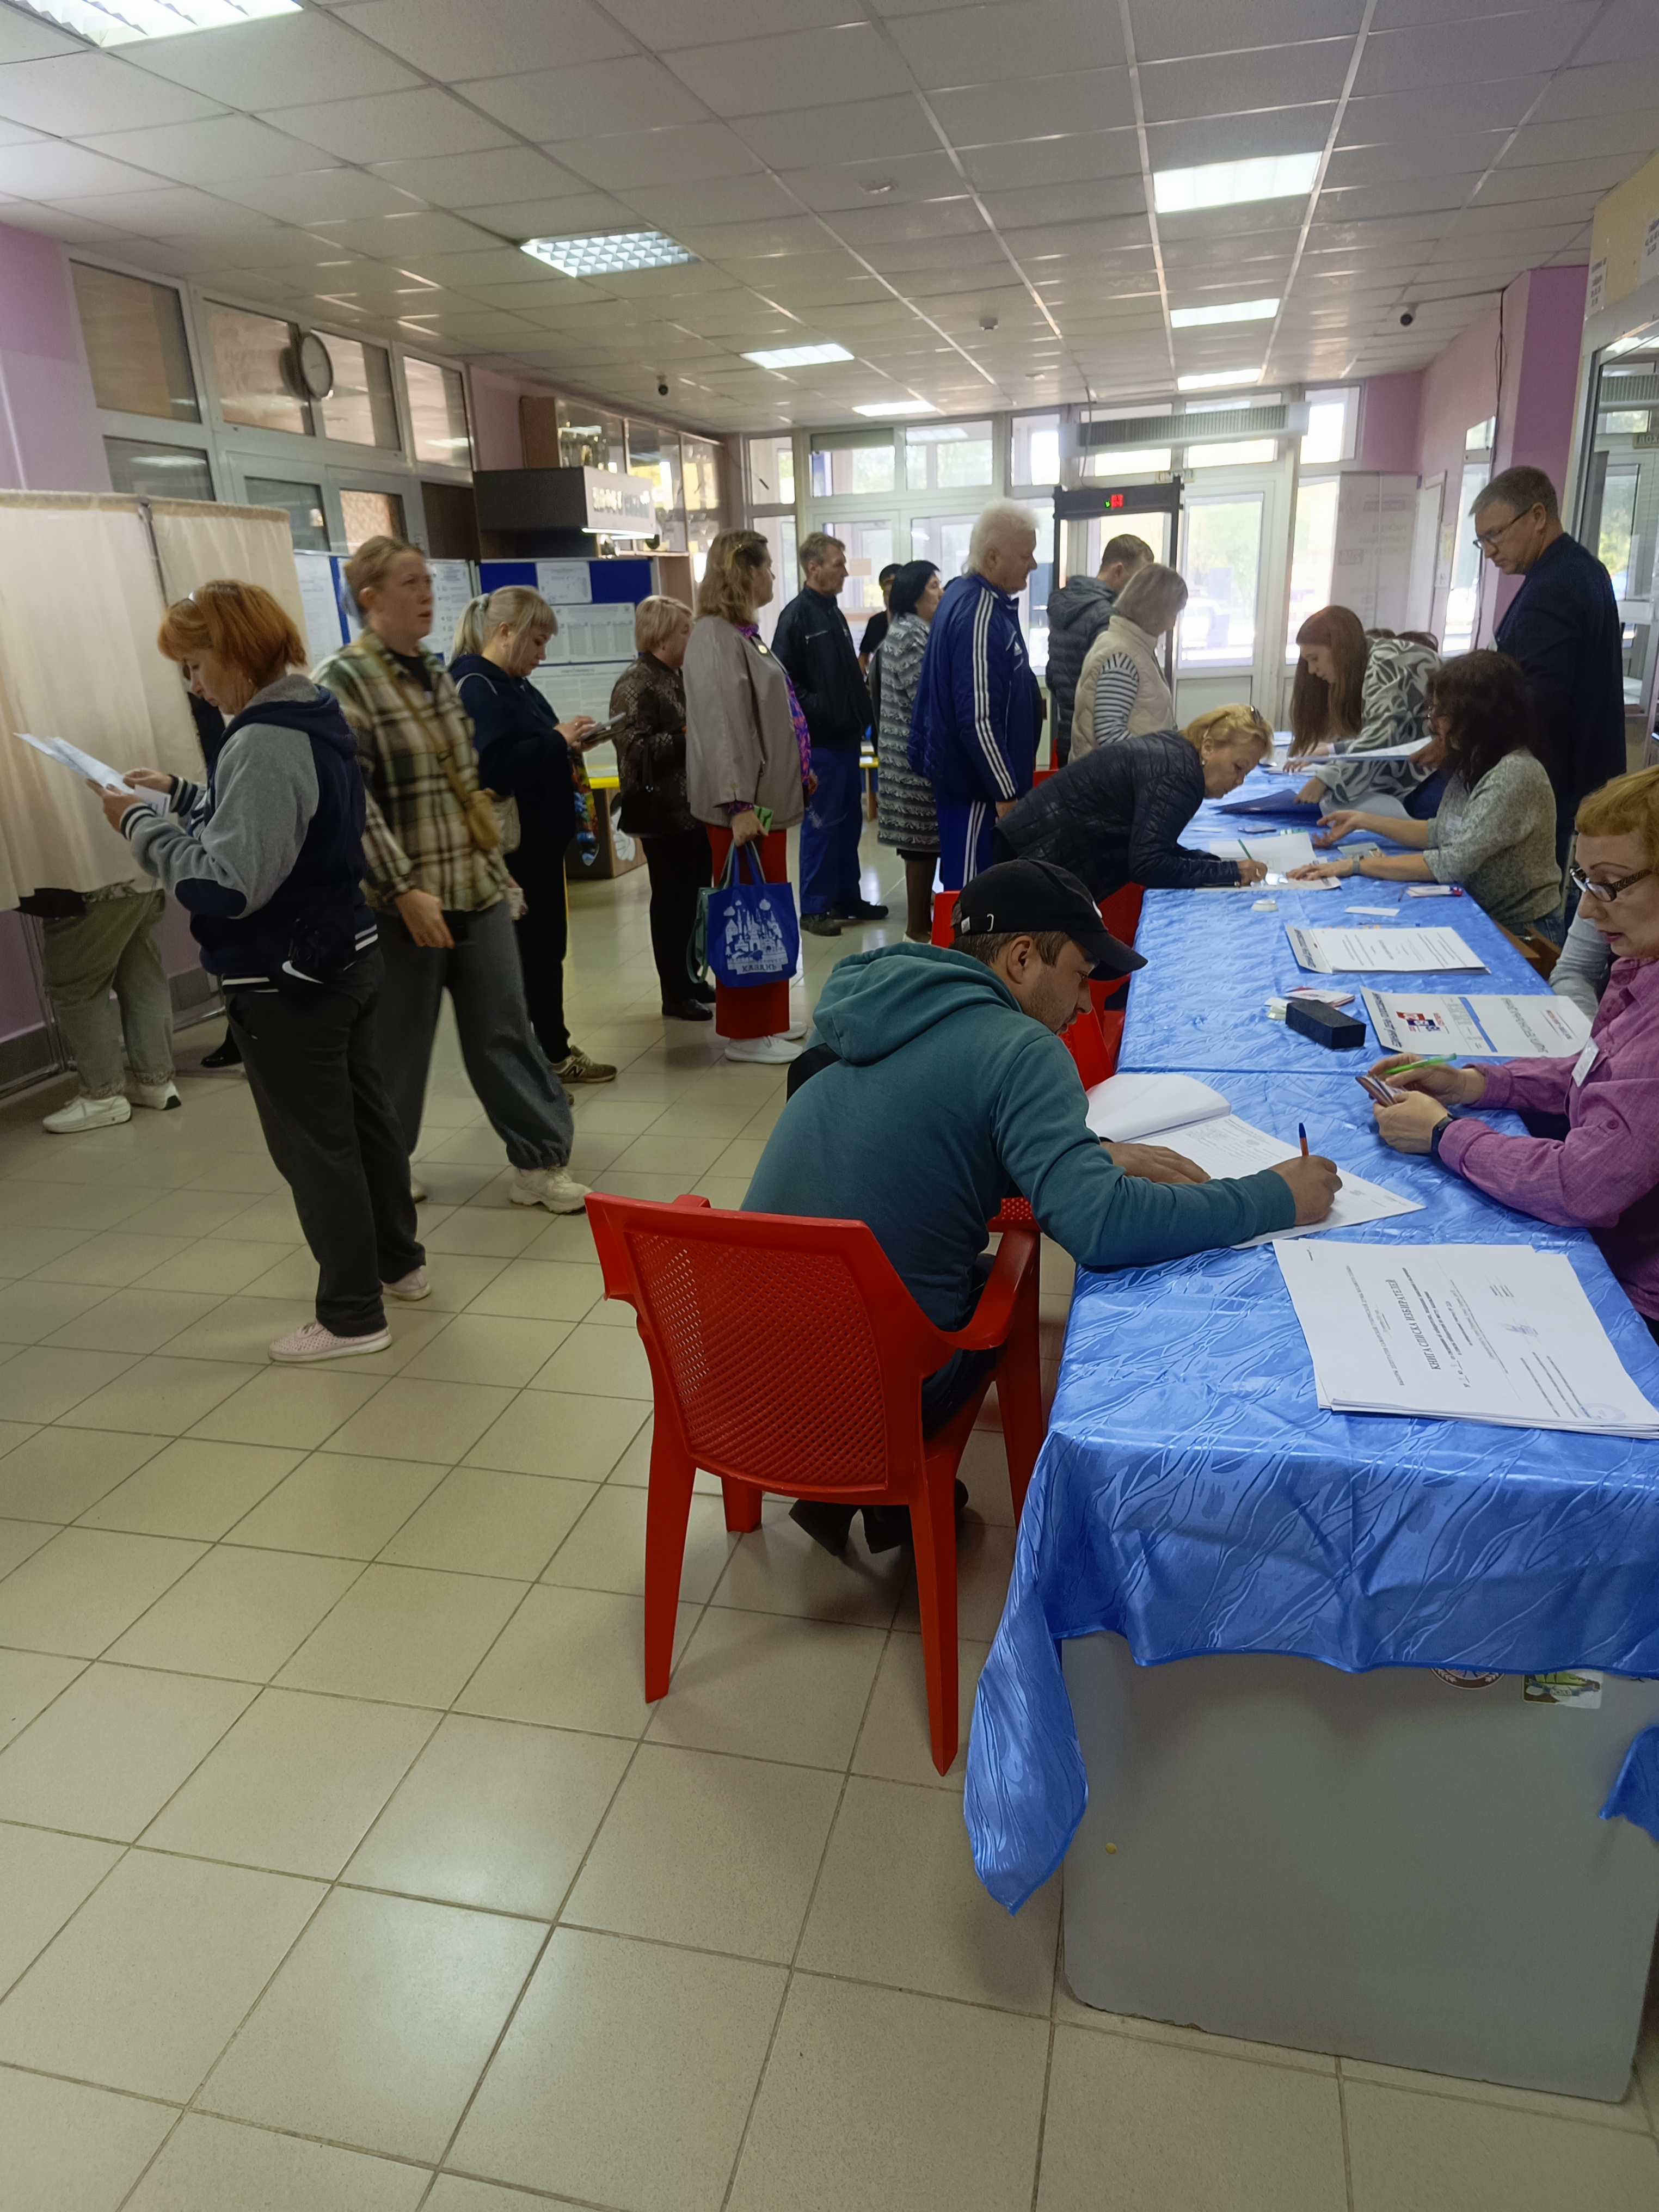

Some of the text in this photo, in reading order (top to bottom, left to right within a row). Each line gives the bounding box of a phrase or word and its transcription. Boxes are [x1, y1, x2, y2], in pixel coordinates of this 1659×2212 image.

[742, 964, 777, 972] КАЗАНЬ
[1385, 1279, 1416, 1322] ИЗБИРАТЕЛЕЙ
[1409, 1322, 1429, 1348] СПИСКА
[1422, 1348, 1441, 1370] КНИГА
